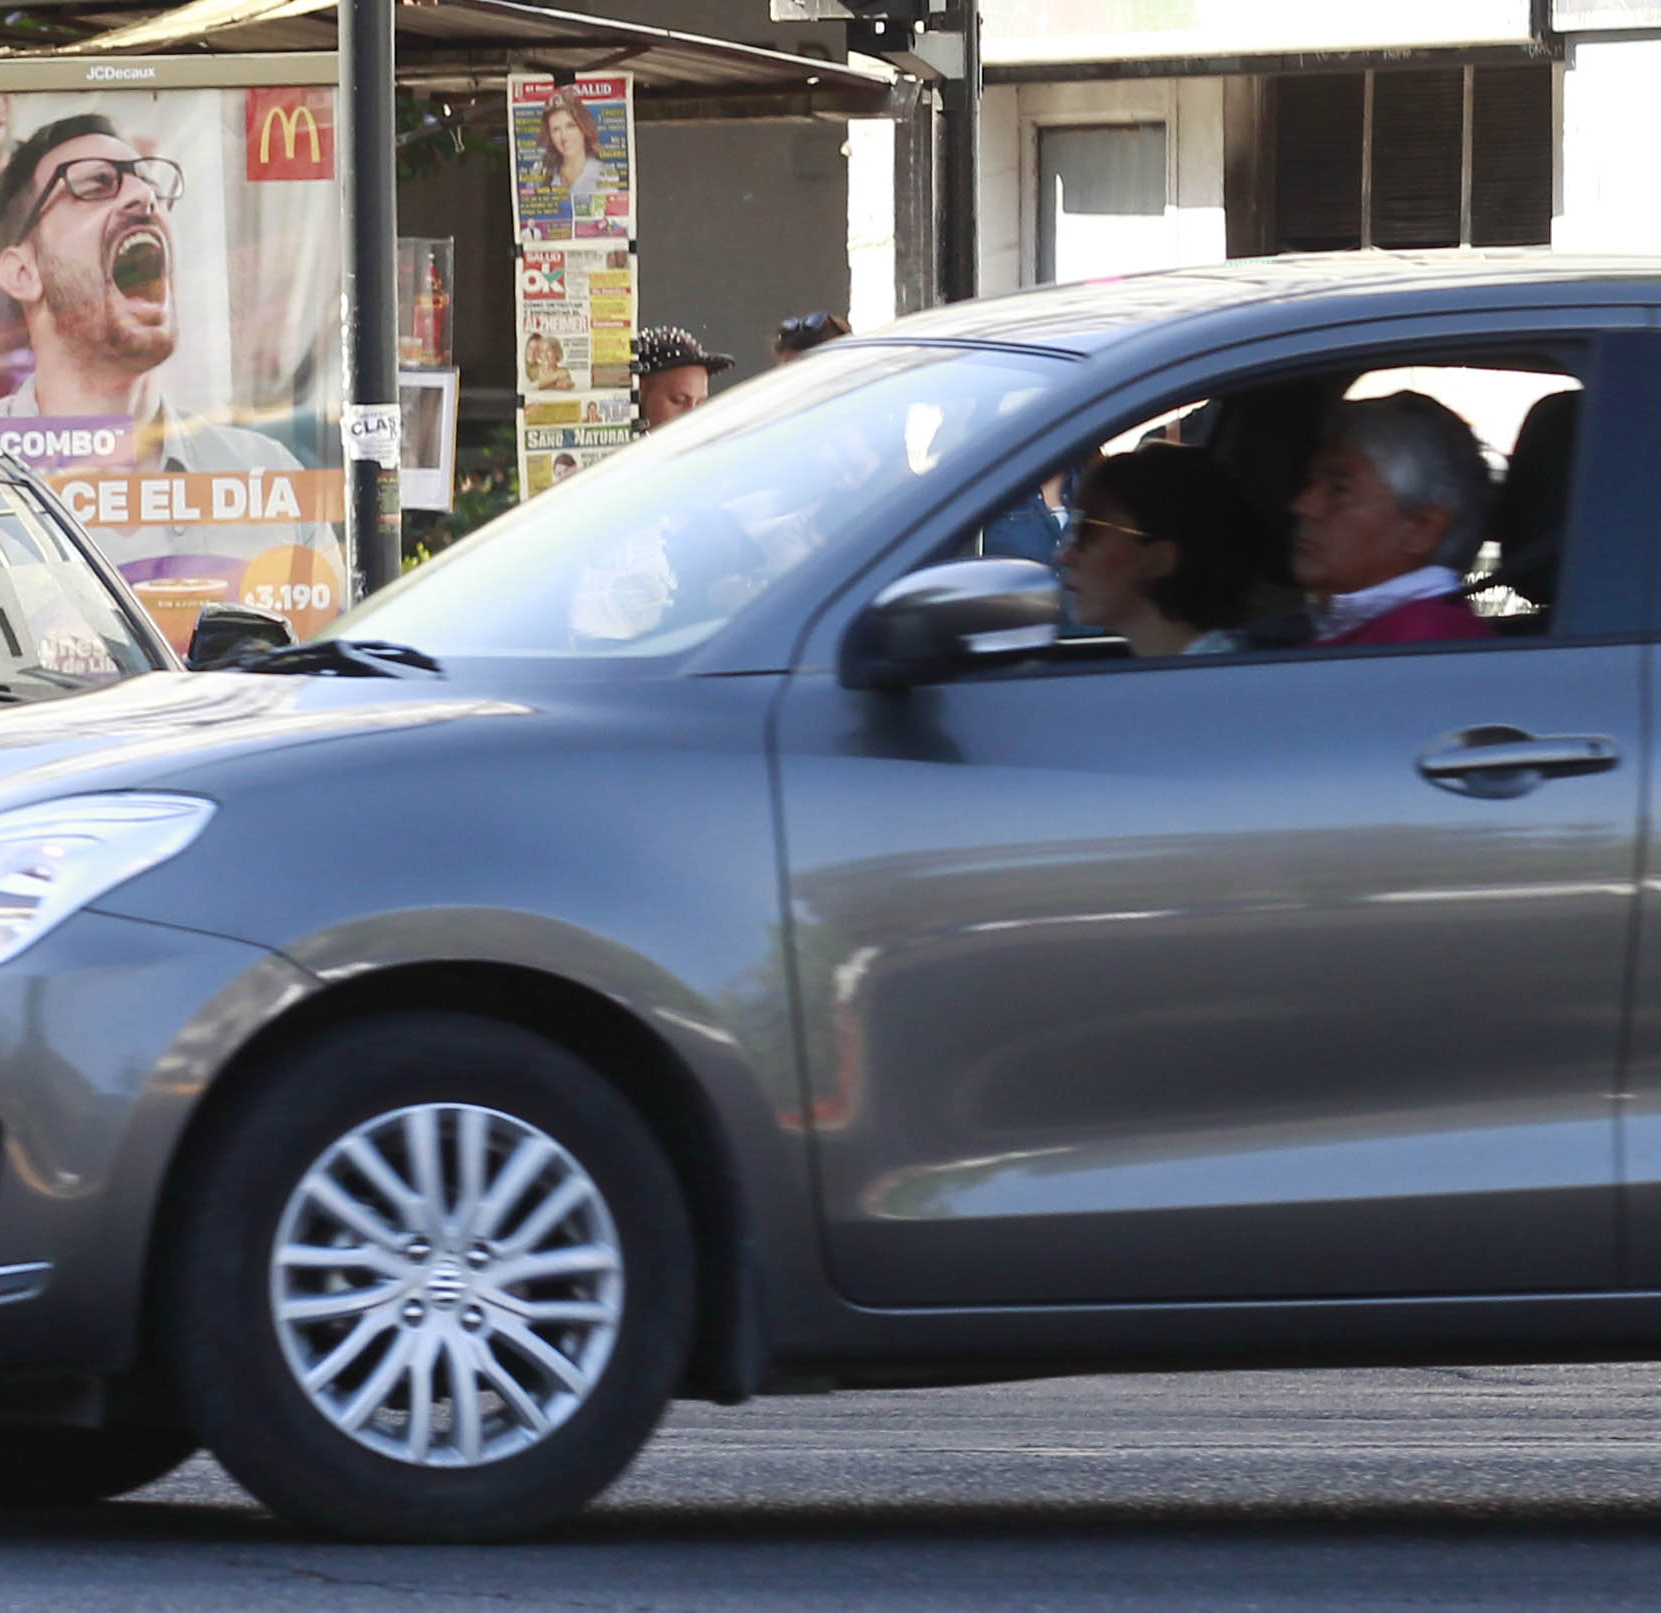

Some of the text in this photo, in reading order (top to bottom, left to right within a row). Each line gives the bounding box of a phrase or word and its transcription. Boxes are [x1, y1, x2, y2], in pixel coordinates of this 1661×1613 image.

[86, 65, 155, 80] JCDecaux
[573, 82, 612, 96] SALUD
[59, 466, 301, 523] CE EL DÍA
